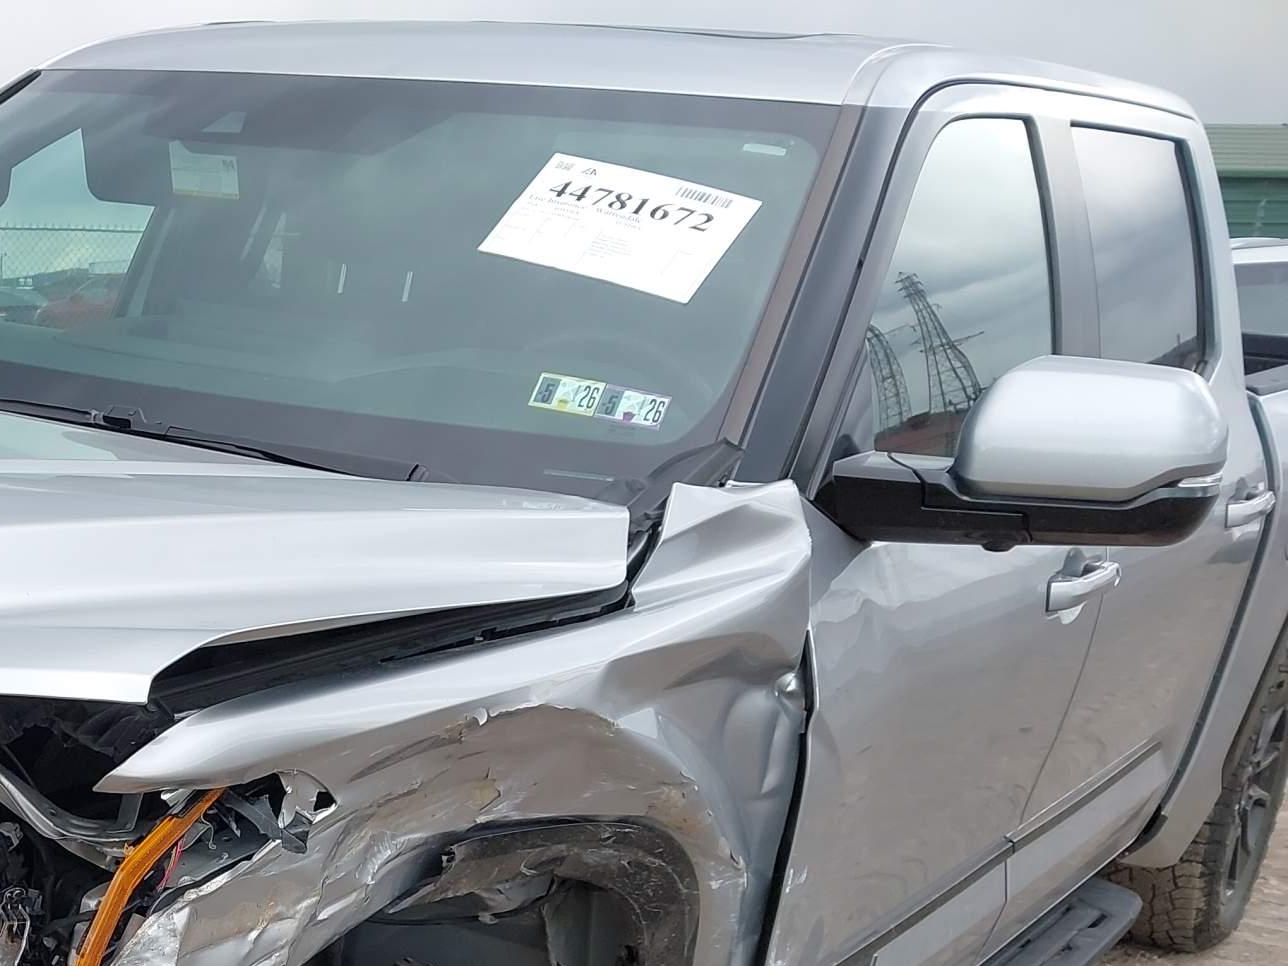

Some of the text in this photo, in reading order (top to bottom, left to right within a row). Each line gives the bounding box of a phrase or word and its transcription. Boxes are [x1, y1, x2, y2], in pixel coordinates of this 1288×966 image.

[549, 180, 715, 233] 44781672
[577, 385, 600, 409] 26
[643, 398, 666, 423] 26
